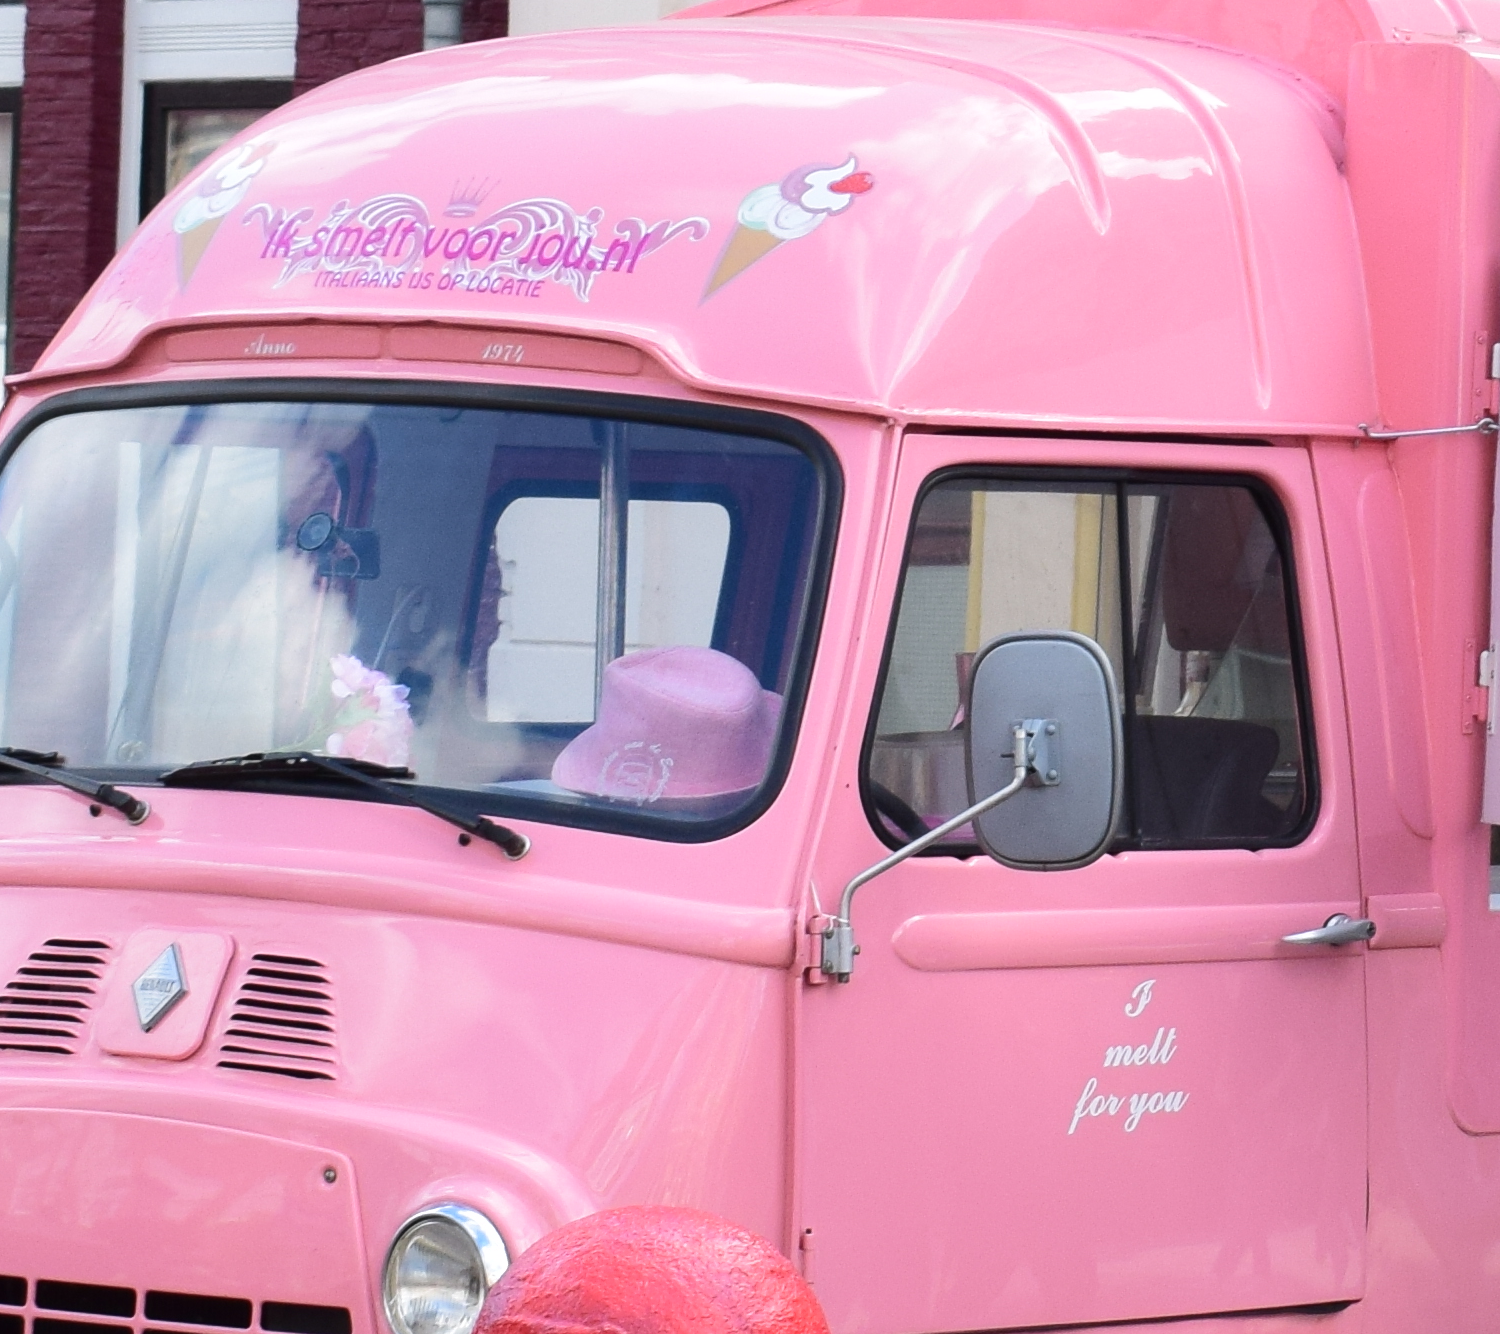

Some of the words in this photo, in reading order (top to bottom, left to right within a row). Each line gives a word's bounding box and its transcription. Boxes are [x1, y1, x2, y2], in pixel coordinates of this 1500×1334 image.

[304, 218, 409, 259] smelt
[422, 227, 515, 264] voor
[314, 269, 407, 289] ITALIAANS
[409, 271, 432, 291] IJS
[437, 273, 463, 293] OP
[466, 276, 545, 299] LOCATIE
[244, 333, 296, 355] Anno
[481, 342, 525, 363] 1974
[1103, 1027, 1177, 1068] melt
[1067, 1077, 1127, 1136] for
[1128, 1091, 1190, 1133] you
